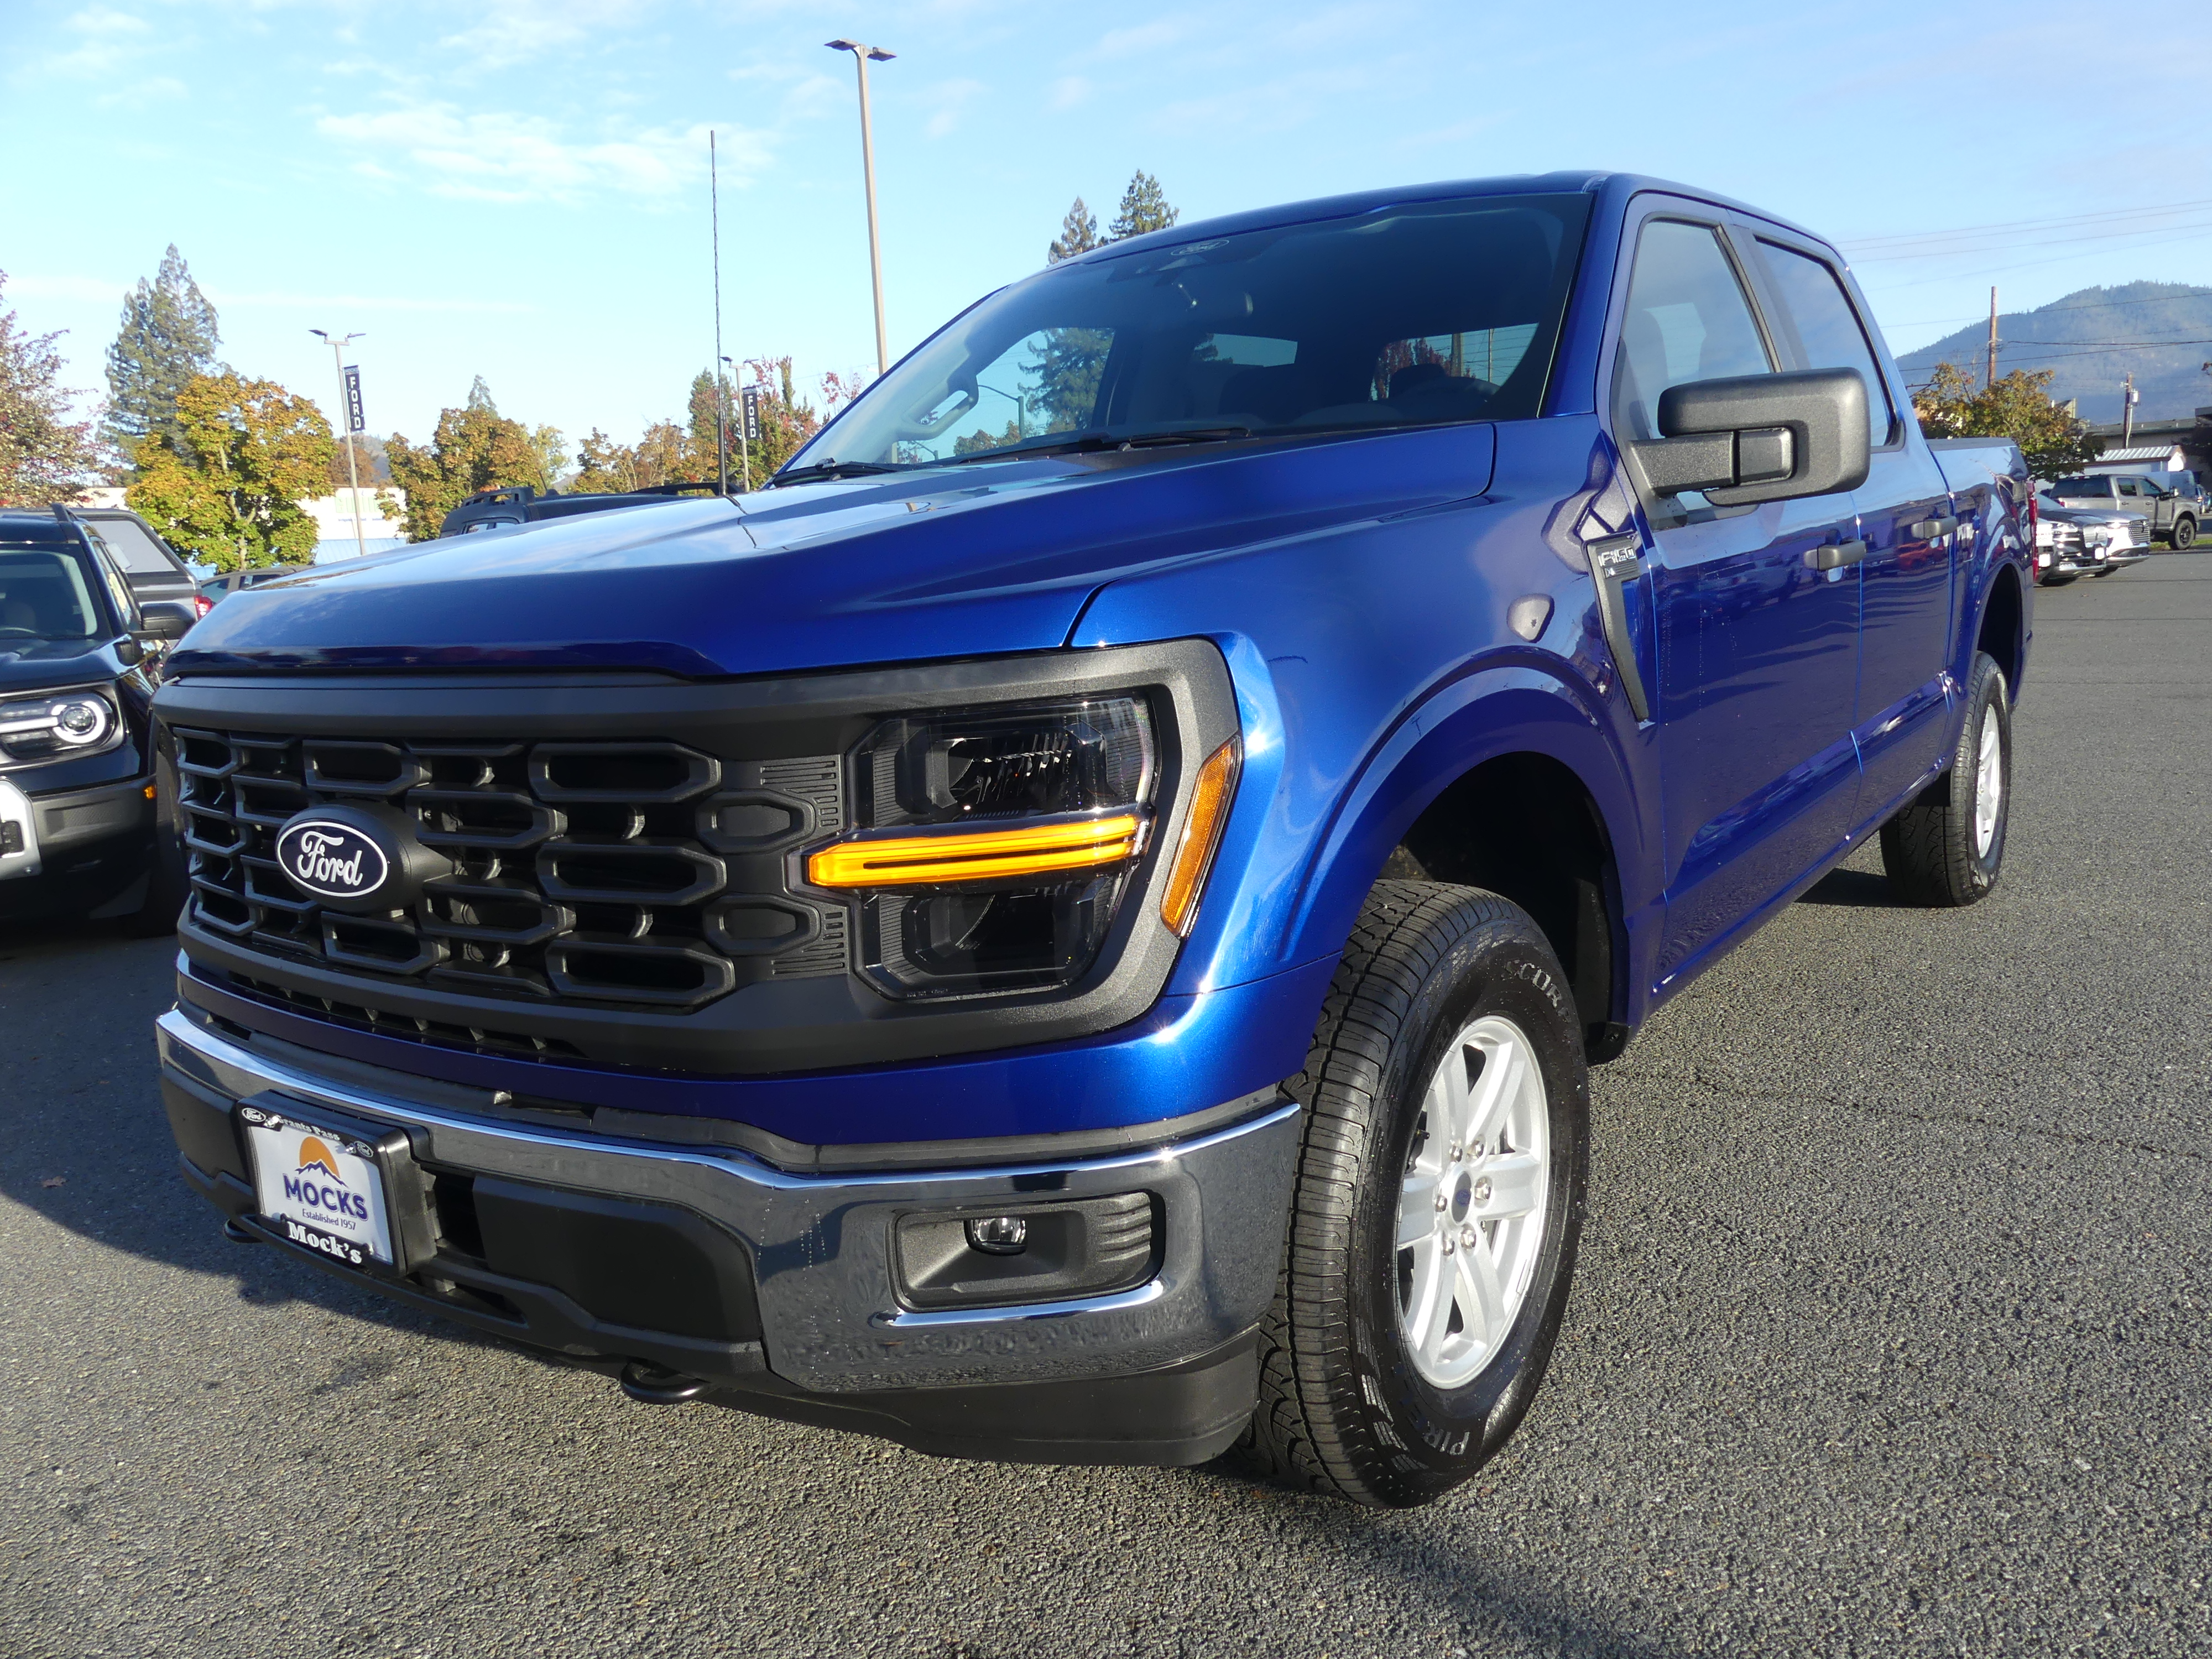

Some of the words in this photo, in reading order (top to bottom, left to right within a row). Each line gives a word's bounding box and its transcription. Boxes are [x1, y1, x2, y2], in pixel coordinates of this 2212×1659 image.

[349, 376, 361, 429] FORD
[748, 395, 757, 438] FORD
[297, 831, 363, 886] Ford
[311, 1125, 341, 1141] Pass
[283, 1173, 368, 1222] MOCKS
[302, 1208, 339, 1227] Established
[341, 1218, 356, 1230] 1957
[287, 1220, 363, 1264] Mock's
